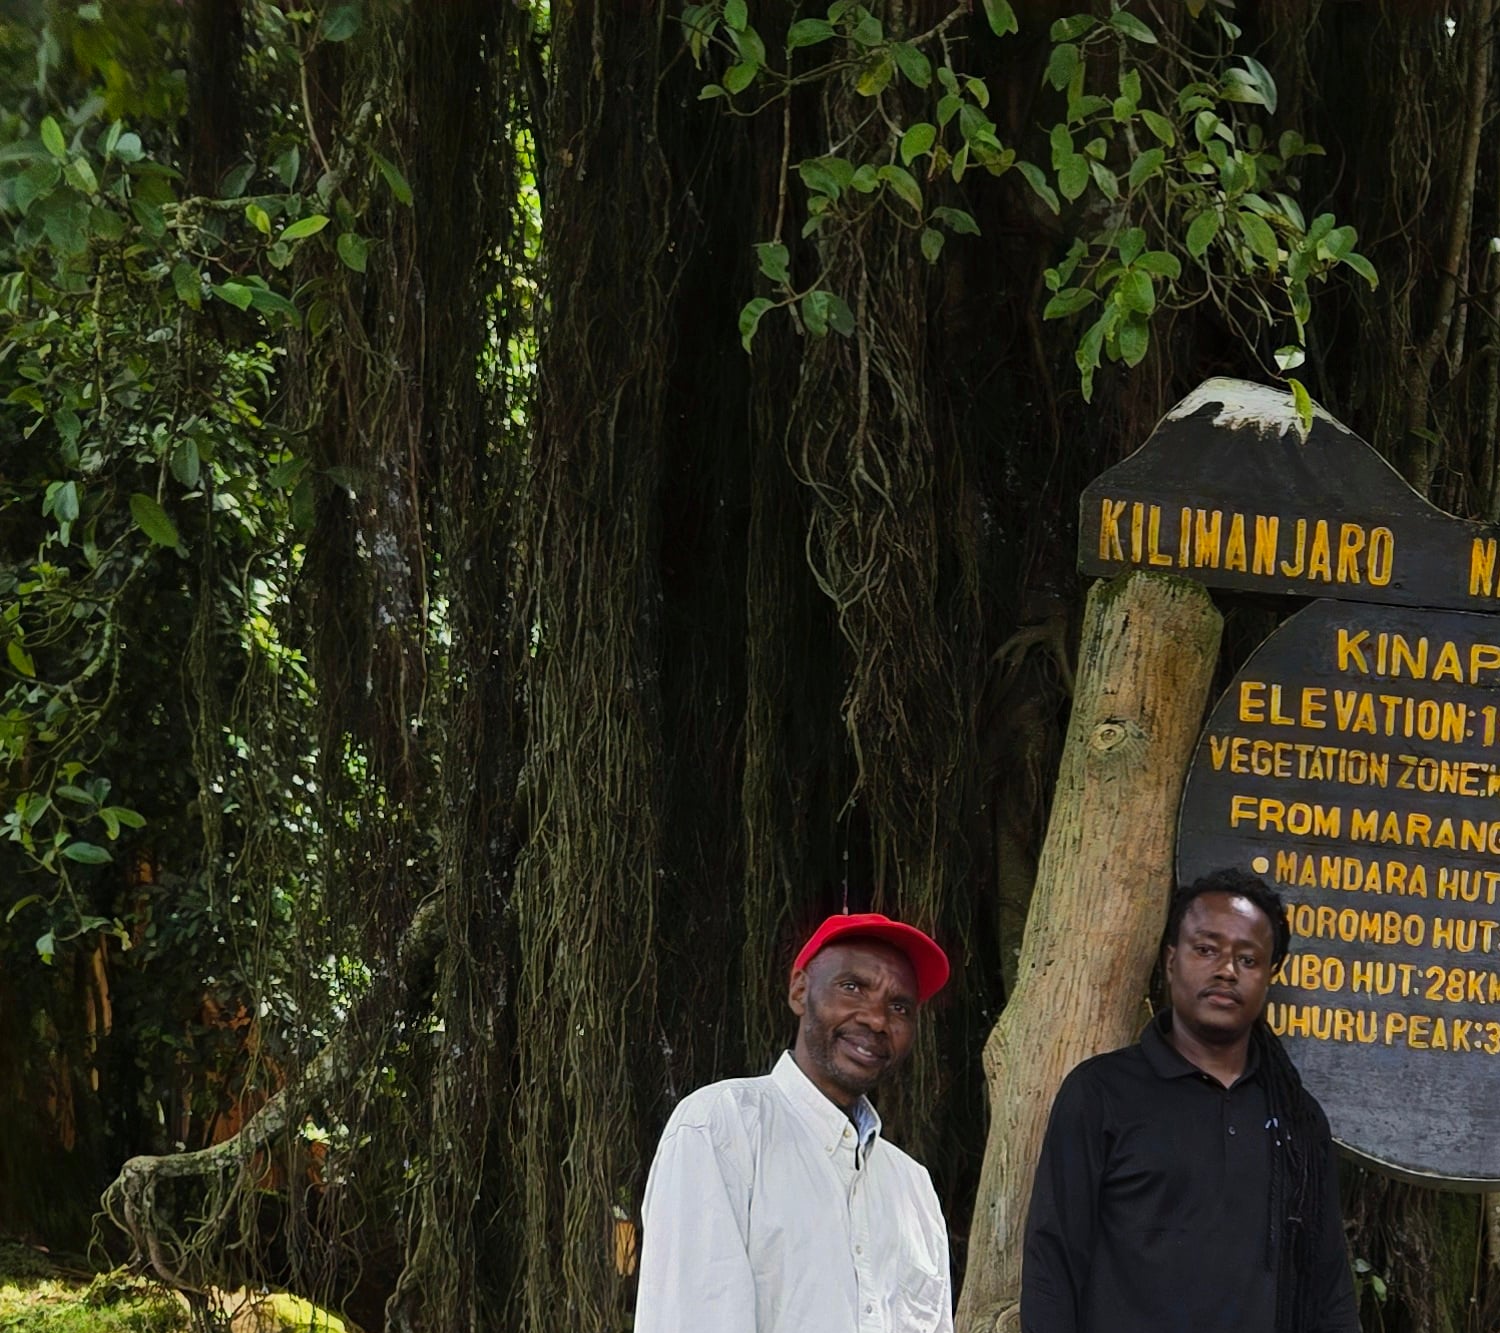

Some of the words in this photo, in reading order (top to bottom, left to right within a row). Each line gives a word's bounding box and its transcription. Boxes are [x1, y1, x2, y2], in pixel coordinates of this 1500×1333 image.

[1099, 498, 1395, 586] KILIMANJARO
[1210, 735, 1390, 788] VEGETATION
[1231, 795, 1342, 839] FROM
[1275, 850, 1428, 898] MANDARA
[1267, 1002, 1378, 1043] UHURU
